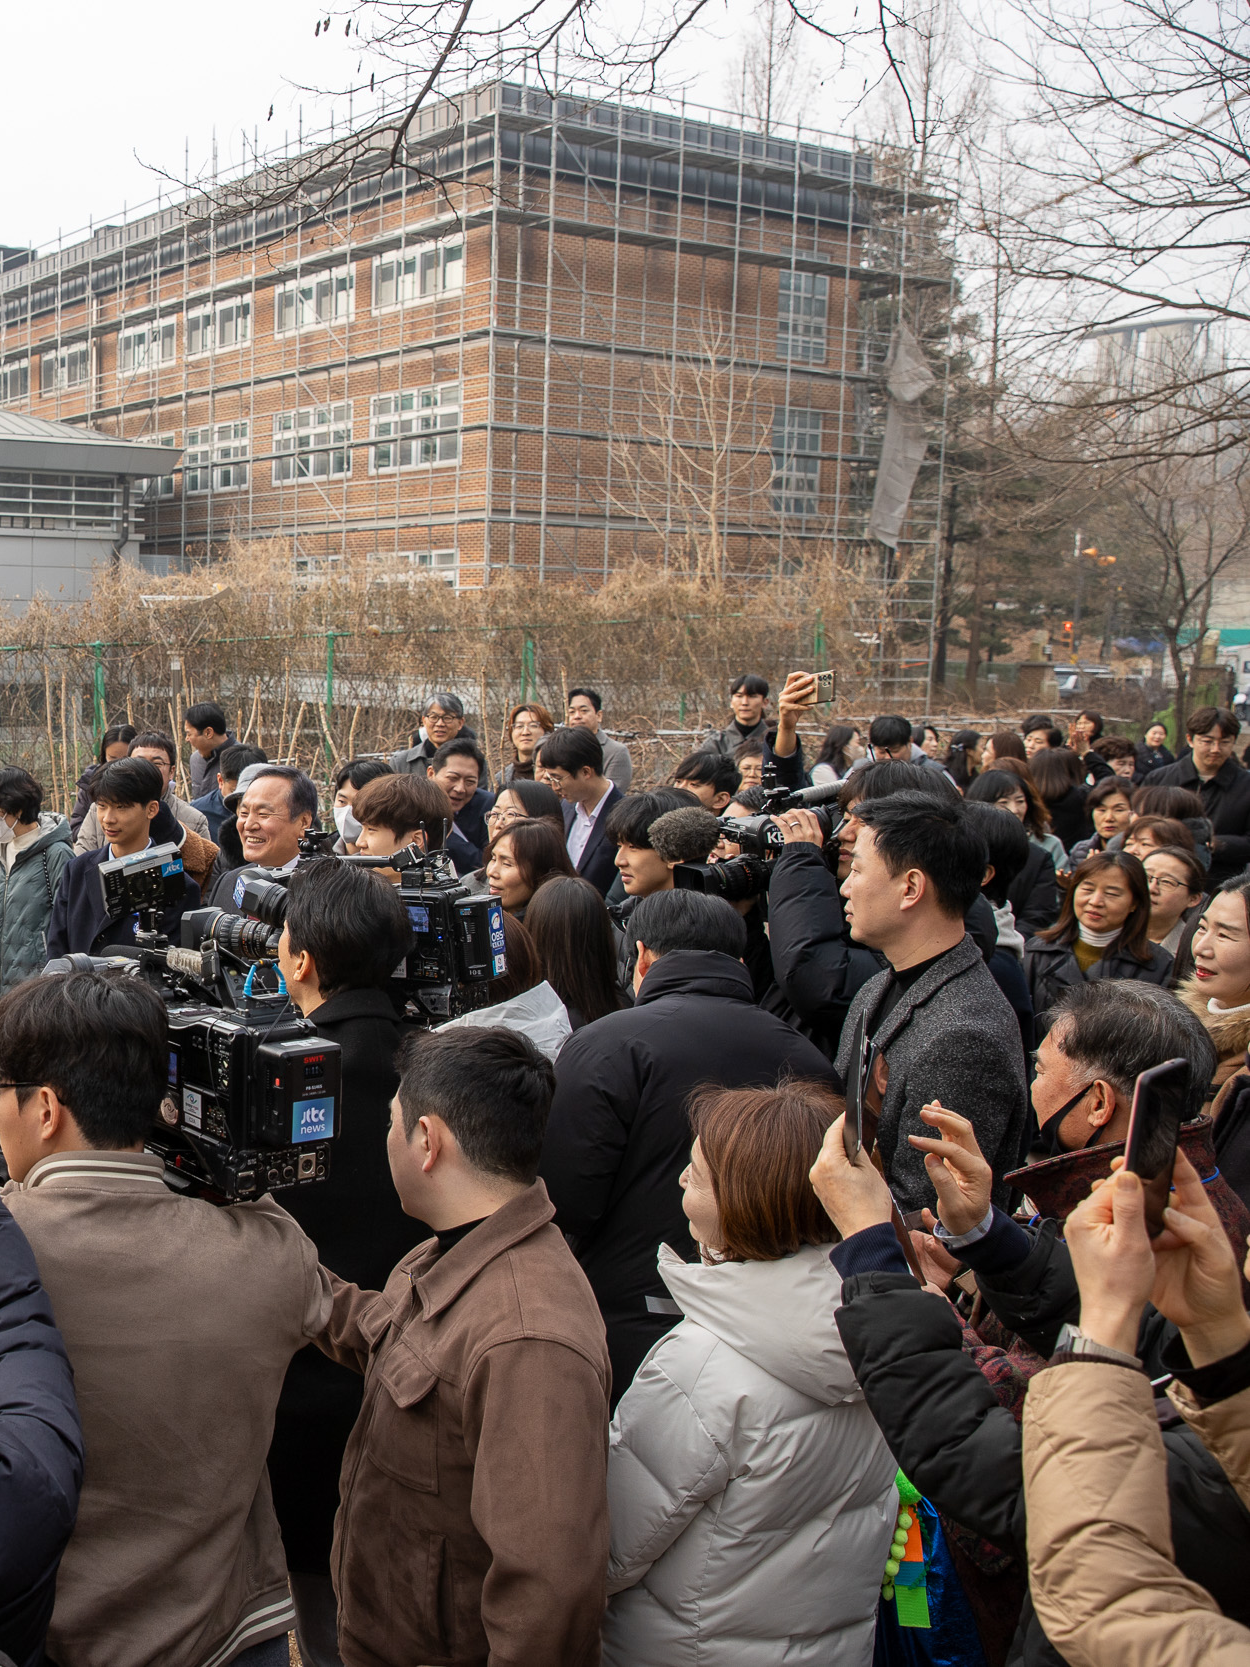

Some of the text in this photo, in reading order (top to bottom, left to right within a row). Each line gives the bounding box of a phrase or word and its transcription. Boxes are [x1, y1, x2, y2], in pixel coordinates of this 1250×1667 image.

[492, 930, 503, 942] OBS
[303, 1055, 324, 1063] SWIT
[300, 1107, 325, 1124] jtbc
[301, 1124, 325, 1134] news
